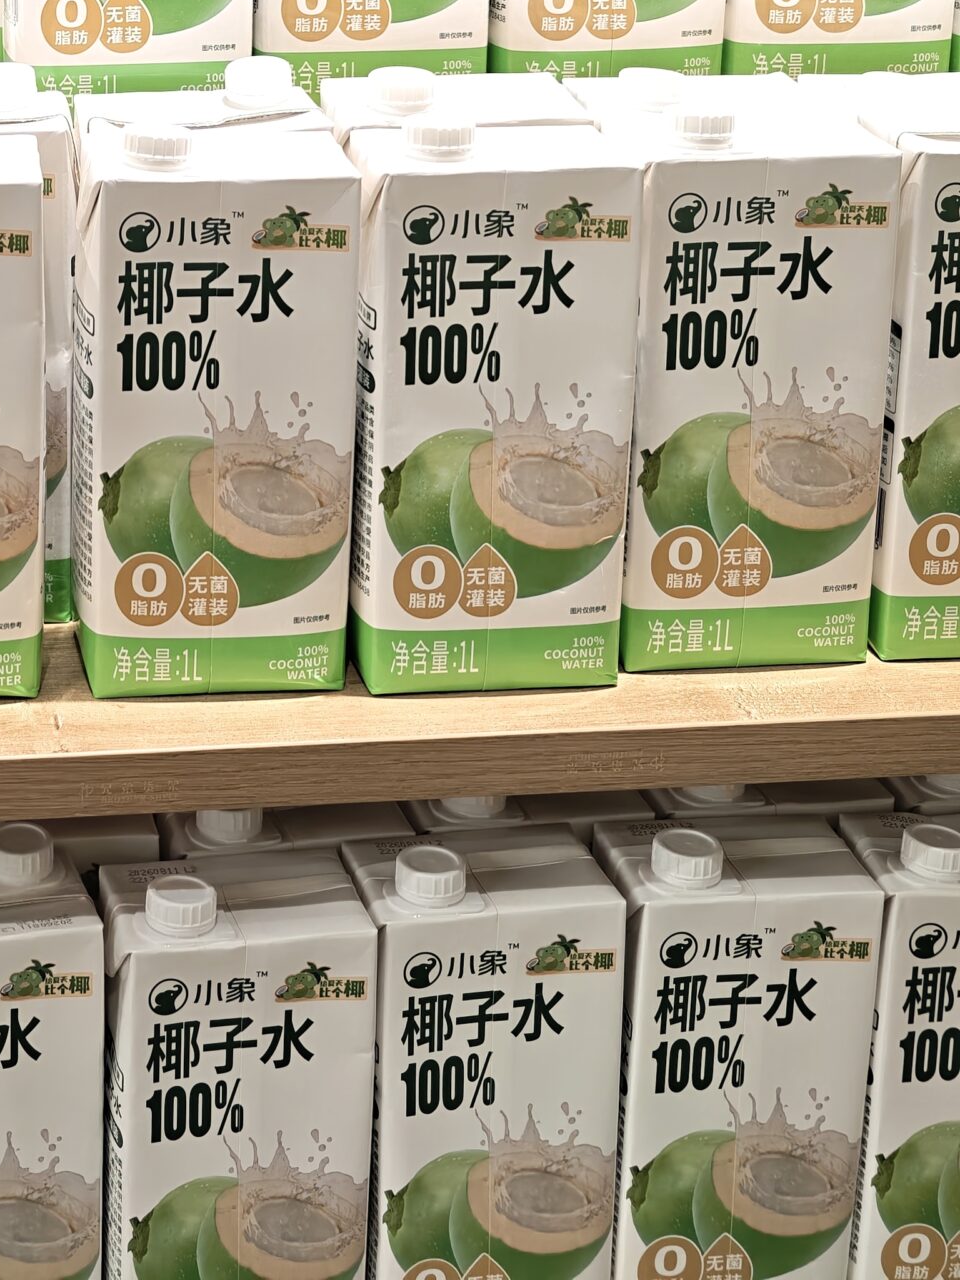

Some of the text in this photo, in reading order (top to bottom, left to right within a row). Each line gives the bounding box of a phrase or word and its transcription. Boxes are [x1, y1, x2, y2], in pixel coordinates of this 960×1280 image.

[106, 6, 142, 24] 无菌
[346, 14, 382, 32] 灌装
[541, 17, 575, 31] 脂肪
[592, 14, 627, 31] 灌装
[768, 10, 802, 24] 脂肪
[820, 7, 854, 24] 灌装
[295, 18, 328, 33] 脂肪
[681, 29, 712, 38] 图片仅供参考
[911, 24, 942, 32] 图片仅供参考
[55, 30, 88, 46] 脂肪
[106, 27, 142, 44] 灌装
[439, 31, 473, 40] 图片仅供参考
[201, 43, 236, 52] 图片仅供参考
[913, 52, 939, 61] 100%
[442, 59, 472, 70] 100%
[684, 57, 710, 67] 100%
[713, 196, 776, 225] 小象
[167, 217, 231, 246] 小象
[450, 209, 515, 238] 小象
[663, 236, 834, 306] 椰子水
[117, 258, 294, 326] 椰子水
[401, 249, 575, 319] 椰子水
[662, 308, 759, 370] 100%
[117, 329, 219, 392] 100%
[400, 322, 500, 386] 100%
[668, 536, 703, 571] 0
[723, 547, 762, 566] 无菌
[410, 555, 445, 590] 0
[466, 566, 506, 586] 无菌
[922, 560, 959, 575] 脂肪
[132, 563, 167, 598] 0
[188, 576, 228, 595] 无菌
[666, 573, 702, 589] 脂肪
[722, 569, 761, 588] 灌装
[822, 583, 858, 593] 图片仅供参考
[409, 592, 446, 609] 脂肪
[466, 589, 506, 607] 灌装
[130, 600, 167, 617] 脂肪
[188, 598, 228, 617] 灌装
[570, 605, 607, 615] 图片仅供参考
[293, 614, 330, 625] 图片仅供参考
[824, 614, 856, 626] 100%
[646, 619, 734, 654] 净含量:1L
[797, 624, 855, 638] COCONUT
[297, 644, 329, 656] 100%
[573, 636, 605, 648] 100%
[813, 635, 854, 648] WATER
[269, 655, 329, 670] COCONUT
[390, 639, 479, 675] 净含量:1L
[544, 647, 604, 660] COCONUT
[113, 647, 203, 682] 净含量:1L
[561, 658, 604, 670] WATER
[287, 667, 328, 681] WATER
[702, 933, 763, 961] 小象
[447, 950, 507, 979] 小象
[194, 978, 256, 1006] 小象
[654, 968, 818, 1035] 椰子水
[401, 982, 565, 1057] 椰子水
[146, 1009, 315, 1083] 椰子水
[651, 1034, 745, 1094] 100%
[400, 1051, 495, 1117] 100%
[146, 1078, 244, 1143] 100%
[706, 1254, 743, 1271] 无菌
